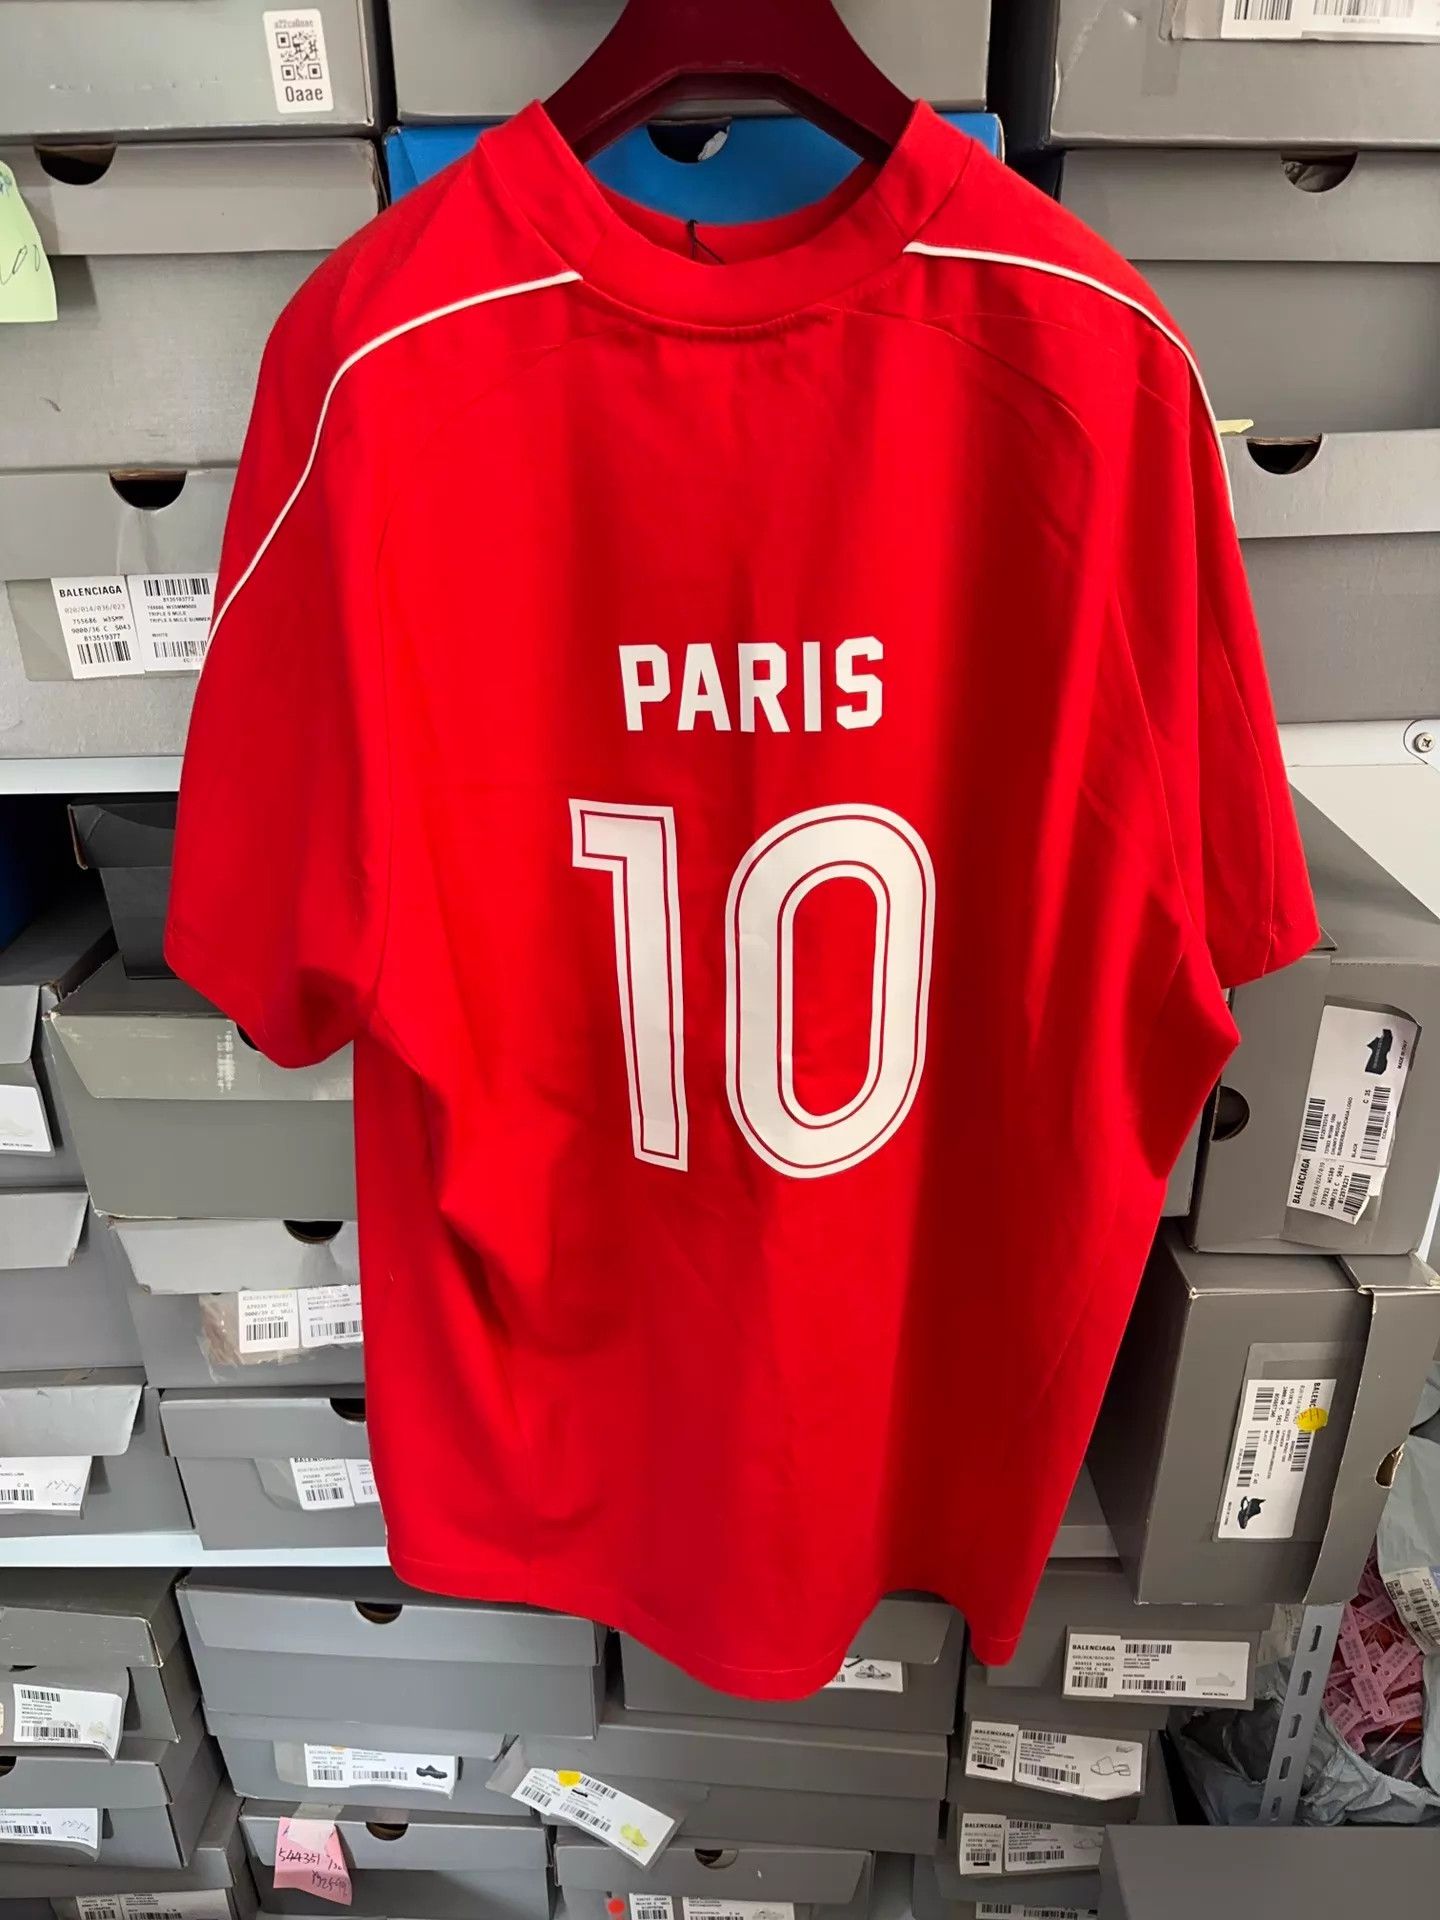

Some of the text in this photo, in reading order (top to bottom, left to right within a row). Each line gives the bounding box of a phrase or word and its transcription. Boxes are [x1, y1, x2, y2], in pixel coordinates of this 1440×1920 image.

[59, 585, 122, 597] BALENCIAGA
[619, 636, 884, 733] PARIS
[569, 798, 936, 1179] 10
[1292, 1158, 1311, 1204] BALENCIAGA
[1309, 1382, 1321, 1408] BALENC
[1072, 1644, 1116, 1652] BALENCIAGA
[974, 1729, 1014, 1738] BALENCIAGA
